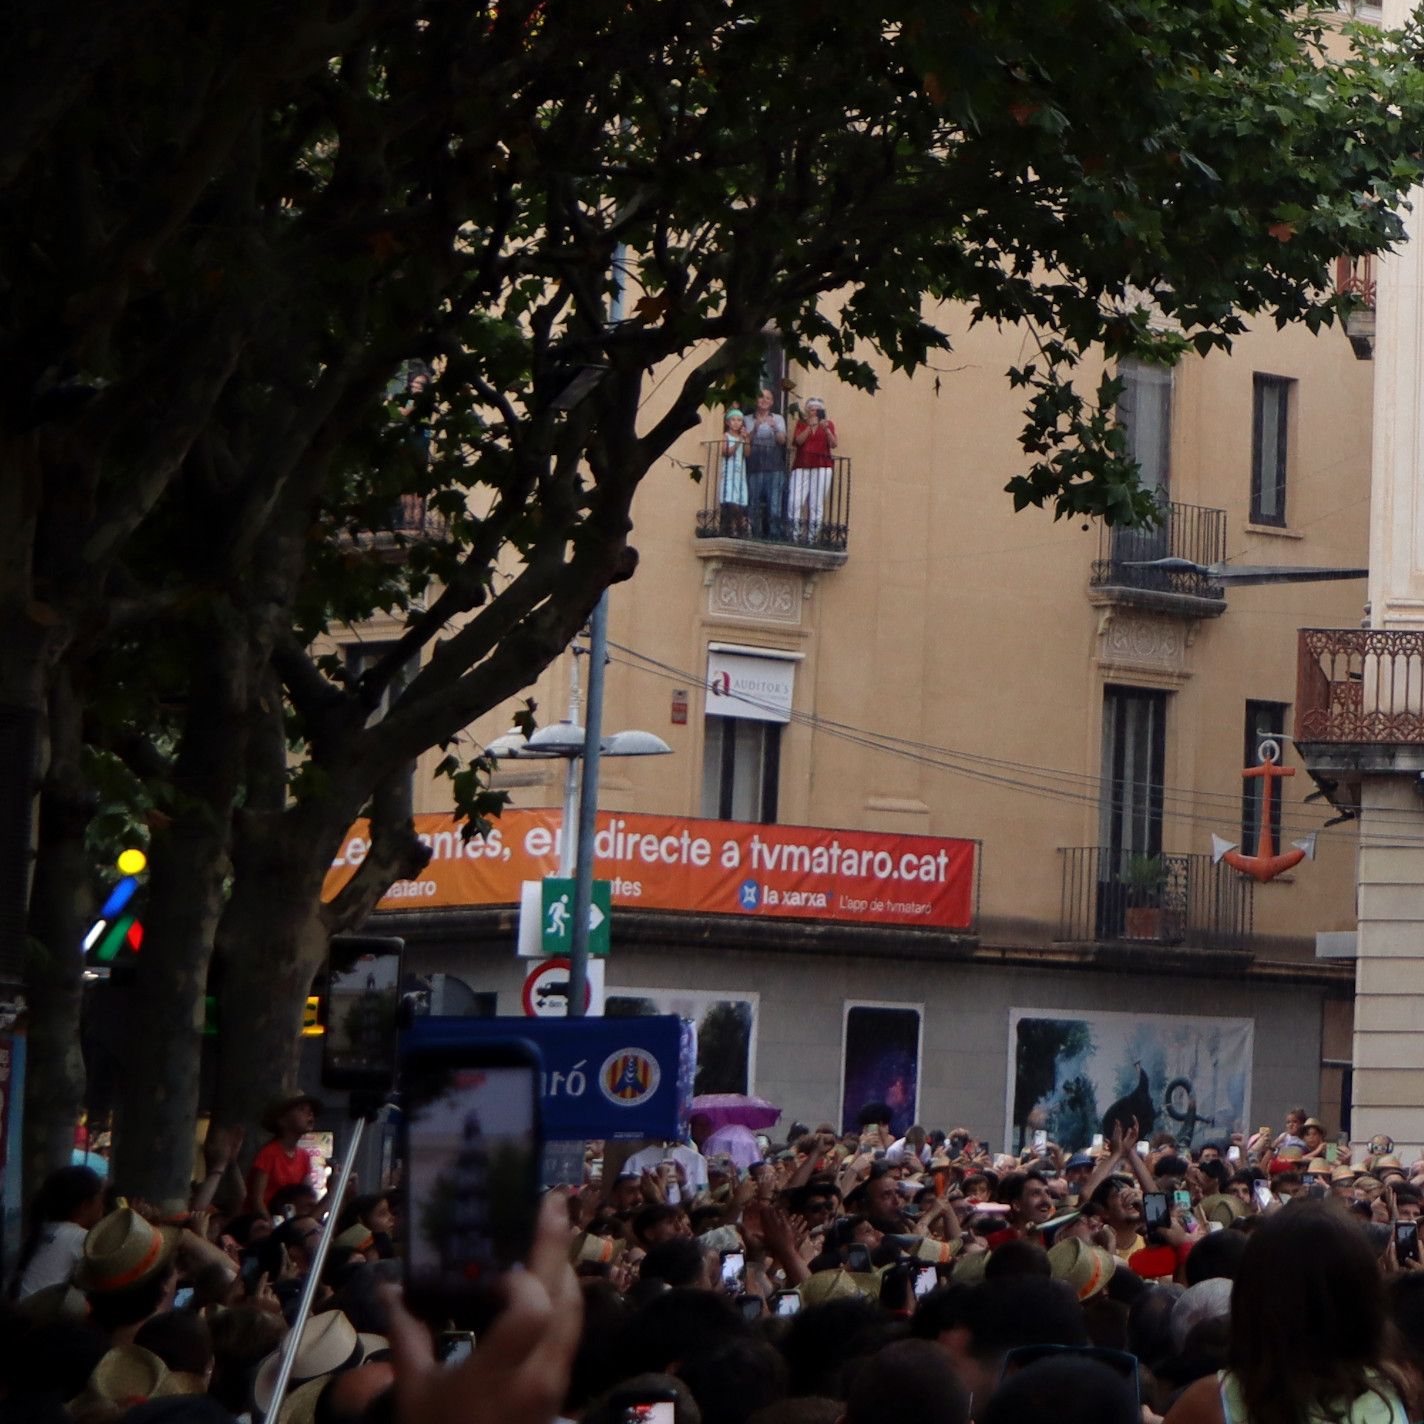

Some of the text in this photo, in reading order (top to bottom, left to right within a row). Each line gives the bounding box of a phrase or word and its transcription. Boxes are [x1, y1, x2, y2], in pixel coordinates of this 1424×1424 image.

[594, 819, 711, 866] directe
[721, 841, 740, 869] a
[751, 834, 949, 883] tvmataro.cat
[763, 885, 779, 905] la
[839, 894, 867, 912] L'app
[869, 896, 884, 911] de
